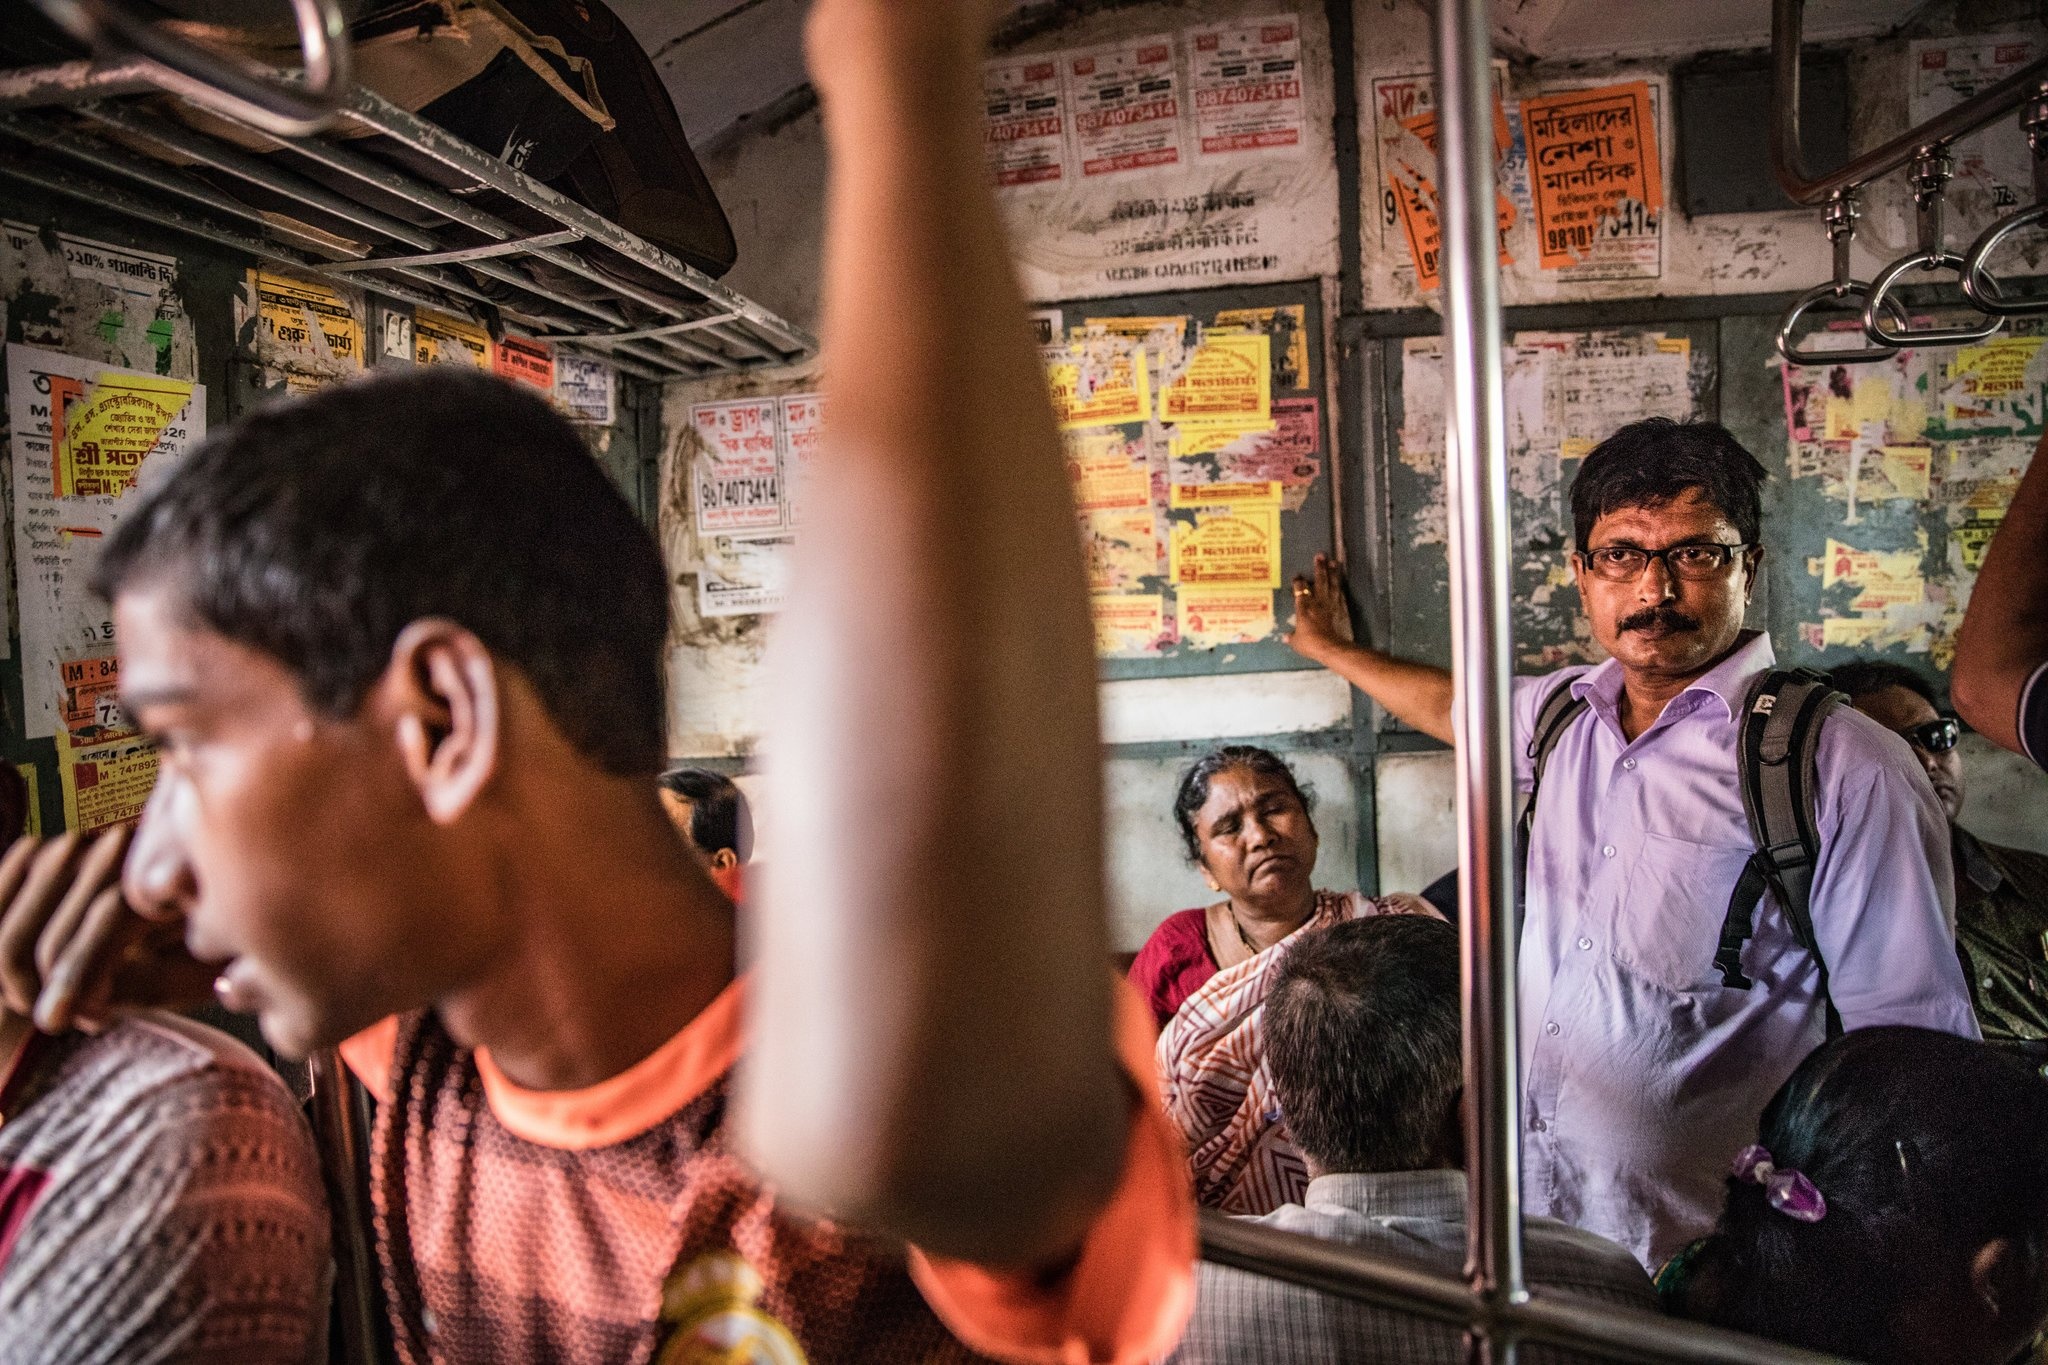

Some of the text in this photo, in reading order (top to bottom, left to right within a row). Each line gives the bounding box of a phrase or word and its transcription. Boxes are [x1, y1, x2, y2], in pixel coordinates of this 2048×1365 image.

[1533, 106, 1632, 138] মহিলাদের
[1539, 135, 1615, 167] নেশা
[1543, 160, 1637, 190] মানসিক
[107, 257, 156, 280] গ্যারান্টি
[74, 441, 101, 465] শ্রী
